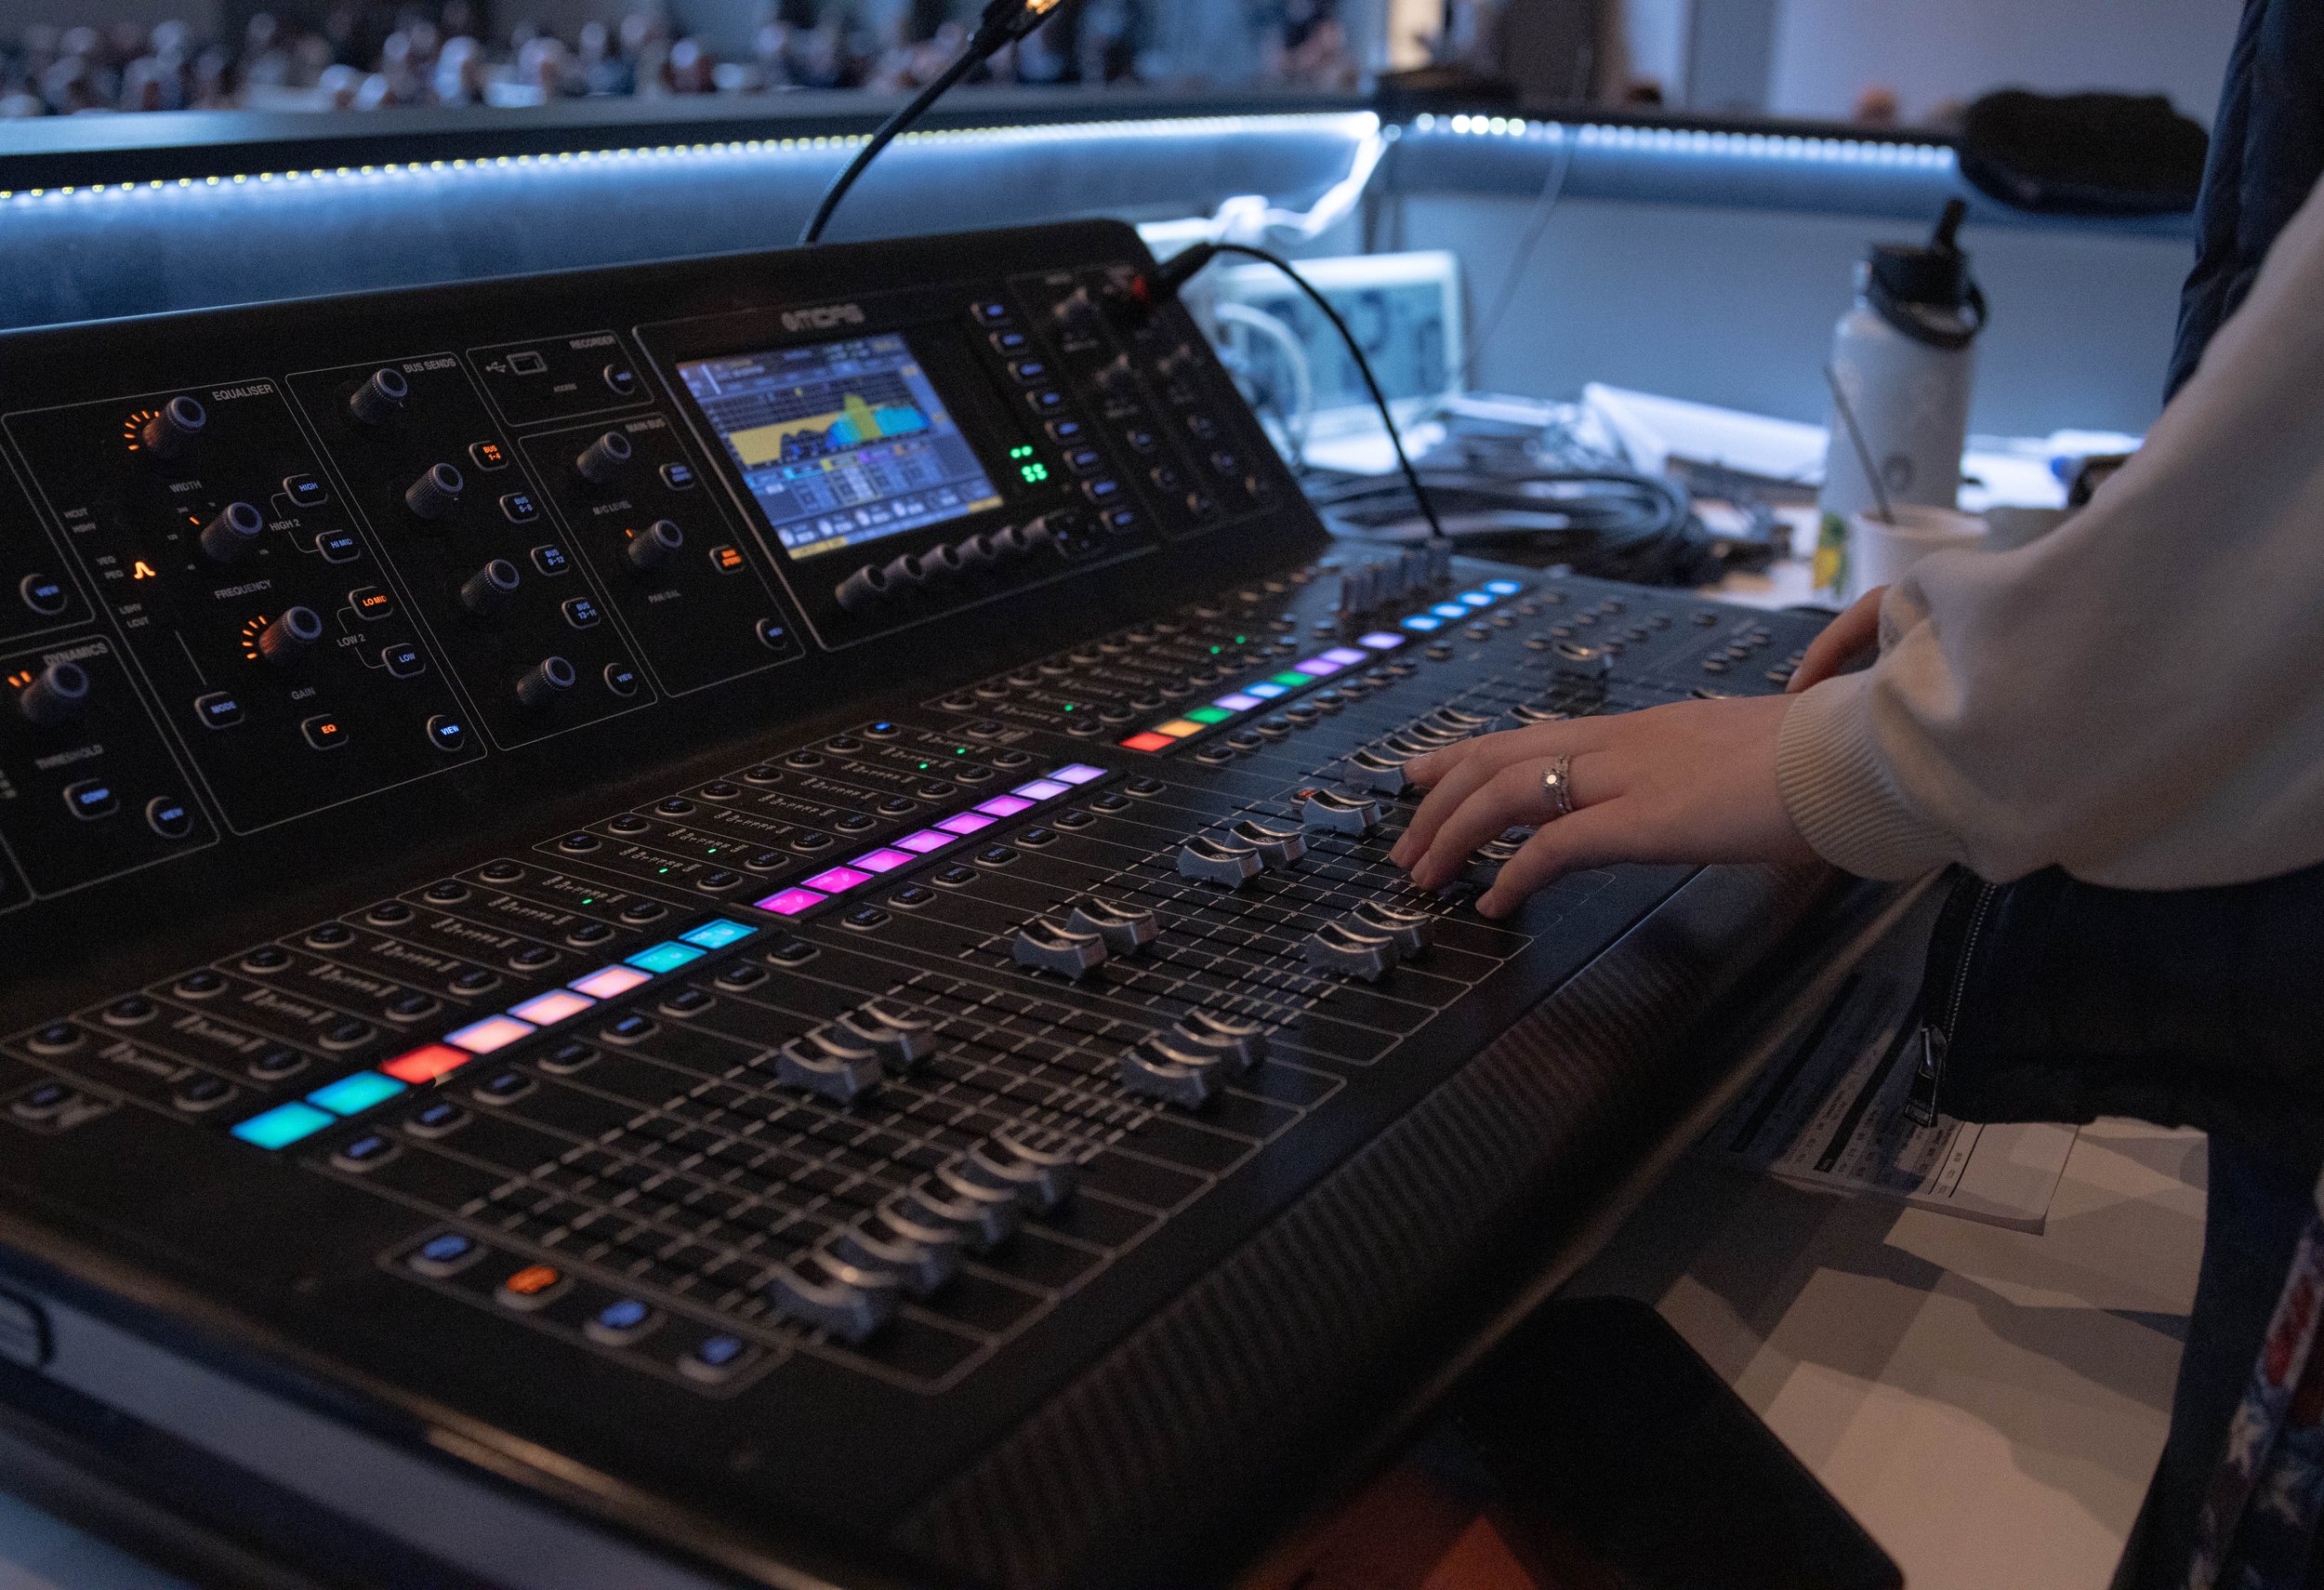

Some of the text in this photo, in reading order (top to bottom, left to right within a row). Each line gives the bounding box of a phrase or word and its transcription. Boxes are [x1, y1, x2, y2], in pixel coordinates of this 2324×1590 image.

[403, 357, 457, 374] BUS SENDS
[212, 384, 273, 402] EQUALISER
[482, 444, 498, 454] BUS
[488, 453, 502, 462] 1-4
[169, 480, 203, 493] WIDTH
[298, 482, 318, 492] HIGH
[513, 497, 528, 506] BUS
[269, 518, 301, 533] HIGH 2
[330, 537, 354, 550] HI MID
[545, 549, 560, 559] BUS
[214, 579, 272, 600] FREQUENCY
[363, 594, 388, 607] LO MID
[576, 602, 591, 612] BUS
[337, 633, 366, 648] LOW 2
[399, 653, 416, 663] LOW
[616, 672, 633, 683] VIEW
[291, 686, 316, 700] GAIN
[210, 701, 237, 714] MODE
[321, 723, 338, 735] EQ
[440, 724, 459, 735] VIEW
